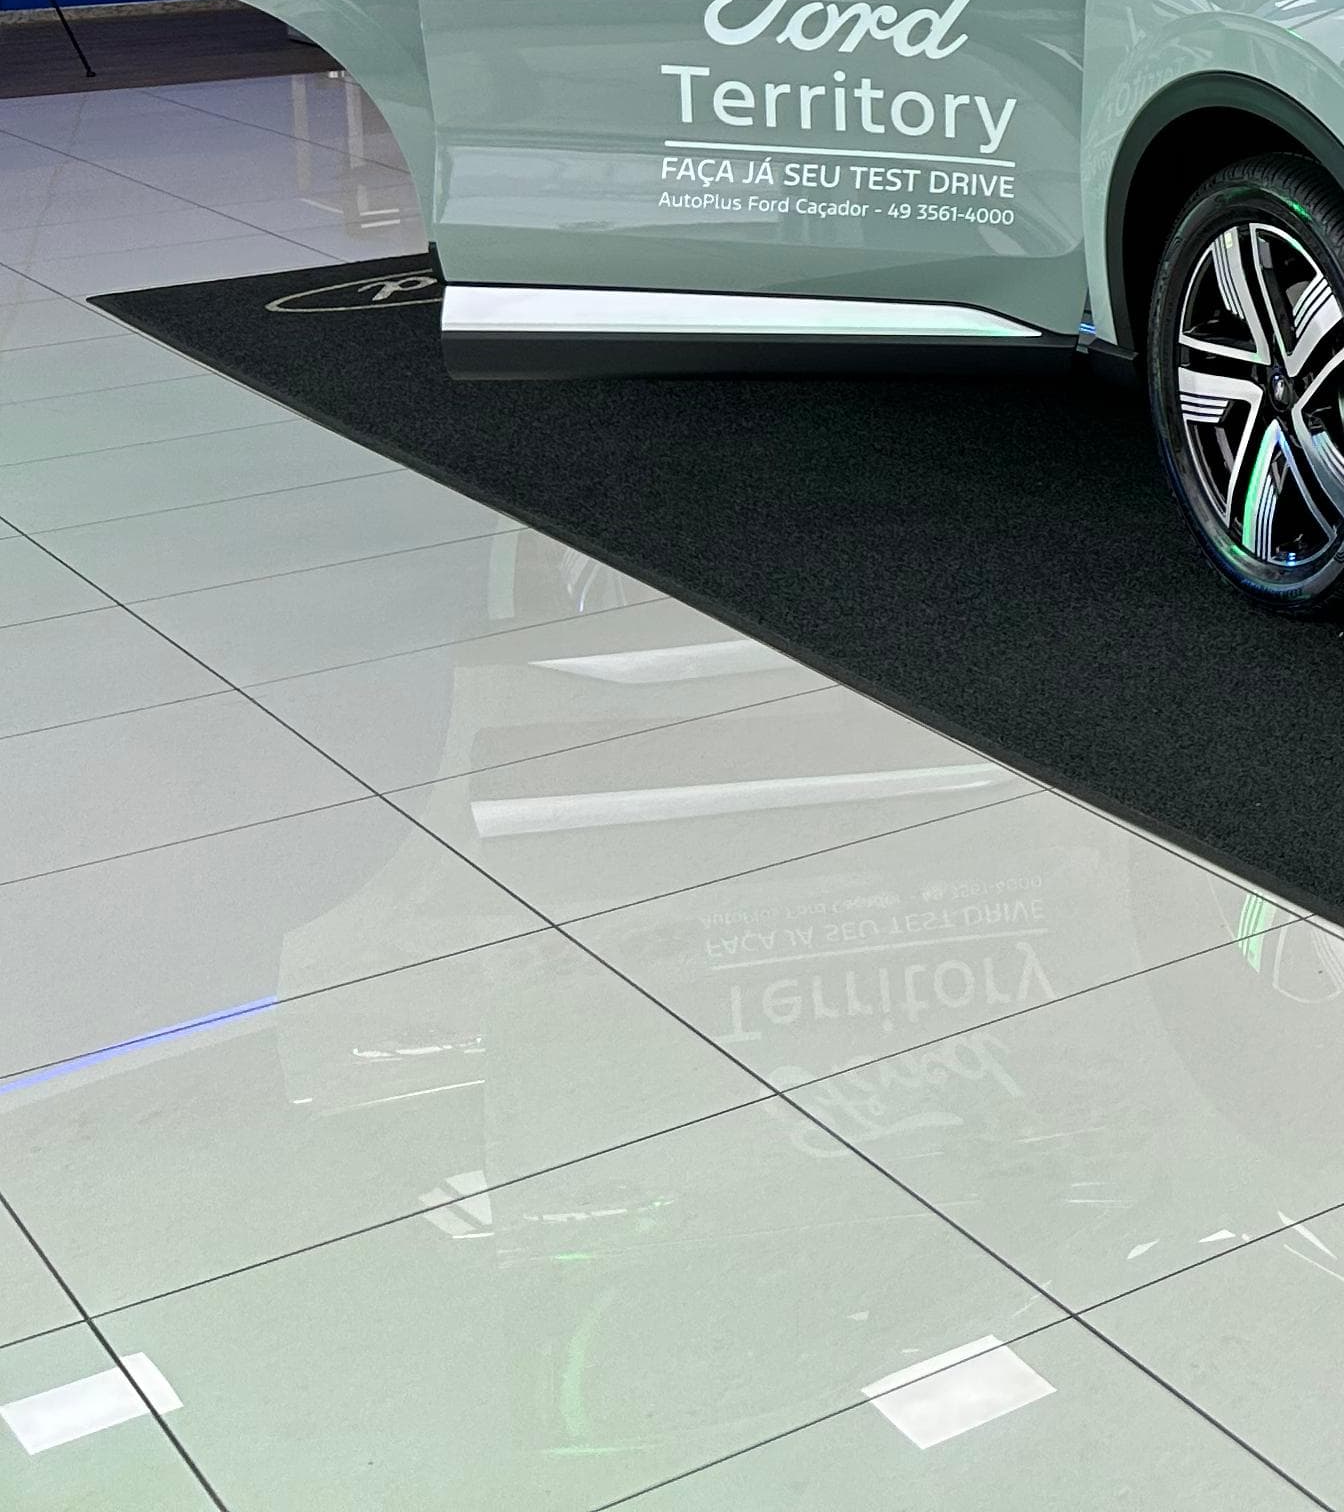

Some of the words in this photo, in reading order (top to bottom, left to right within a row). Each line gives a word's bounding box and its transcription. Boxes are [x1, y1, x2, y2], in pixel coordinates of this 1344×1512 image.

[660, 64, 1018, 155] Territory
[661, 157, 735, 188] FAÇA
[741, 157, 776, 186] JÁ
[784, 162, 841, 189] SEU
[850, 166, 921, 193] TEST
[928, 170, 1016, 199] DRIVE
[658, 191, 743, 211] AutoPlus
[748, 196, 790, 215] Ford
[795, 198, 869, 219] Caçador
[887, 204, 911, 220] 49
[916, 205, 1015, 226] 3561-4000
